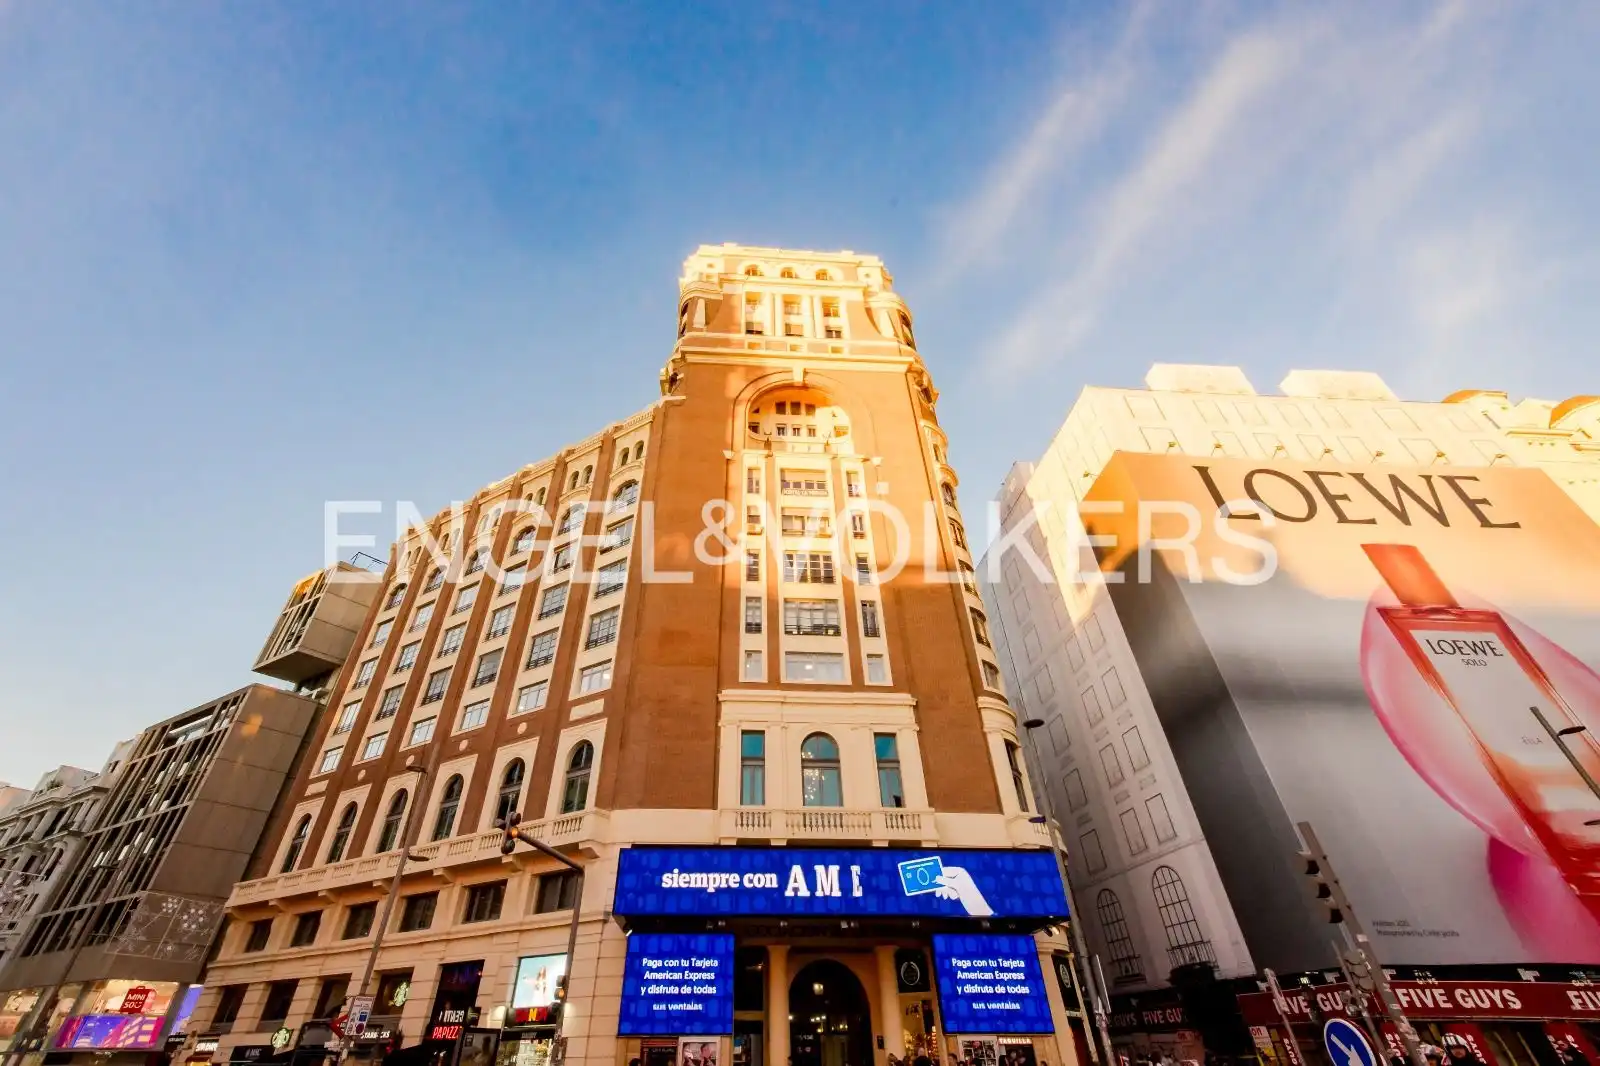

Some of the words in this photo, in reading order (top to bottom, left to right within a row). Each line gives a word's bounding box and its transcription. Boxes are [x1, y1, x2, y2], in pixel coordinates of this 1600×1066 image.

[1192, 465, 1521, 529] LOEWE
[1425, 639, 1504, 657] LOEWE
[1461, 658, 1488, 667] SOLO
[661, 868, 740, 893] siempre
[742, 872, 779, 888] con
[642, 958, 662, 969] Paga
[664, 959, 679, 967] con
[681, 958, 690, 967] tu
[691, 958, 719, 969] Tarjeta
[952, 958, 971, 969] Paga
[973, 959, 987, 967] con
[989, 958, 997, 967] tu
[998, 958, 1025, 969] Tarjeta
[643, 971, 682, 980] American
[684, 971, 715, 981] Express
[957, 971, 994, 980] American
[995, 971, 1025, 981] Express
[641, 986, 646, 996] y
[647, 985, 679, 994] disfruta
[680, 985, 692, 994] de
[693, 985, 717, 994] todas
[956, 985, 962, 995] y
[963, 984, 993, 994] disfruta
[995, 984, 1006, 994] de
[1007, 984, 1030, 994] todas
[1395, 988, 1453, 1008] FIVE
[1454, 988, 1522, 1010] GUYS
[1142, 1010, 1165, 1025] FIVE
